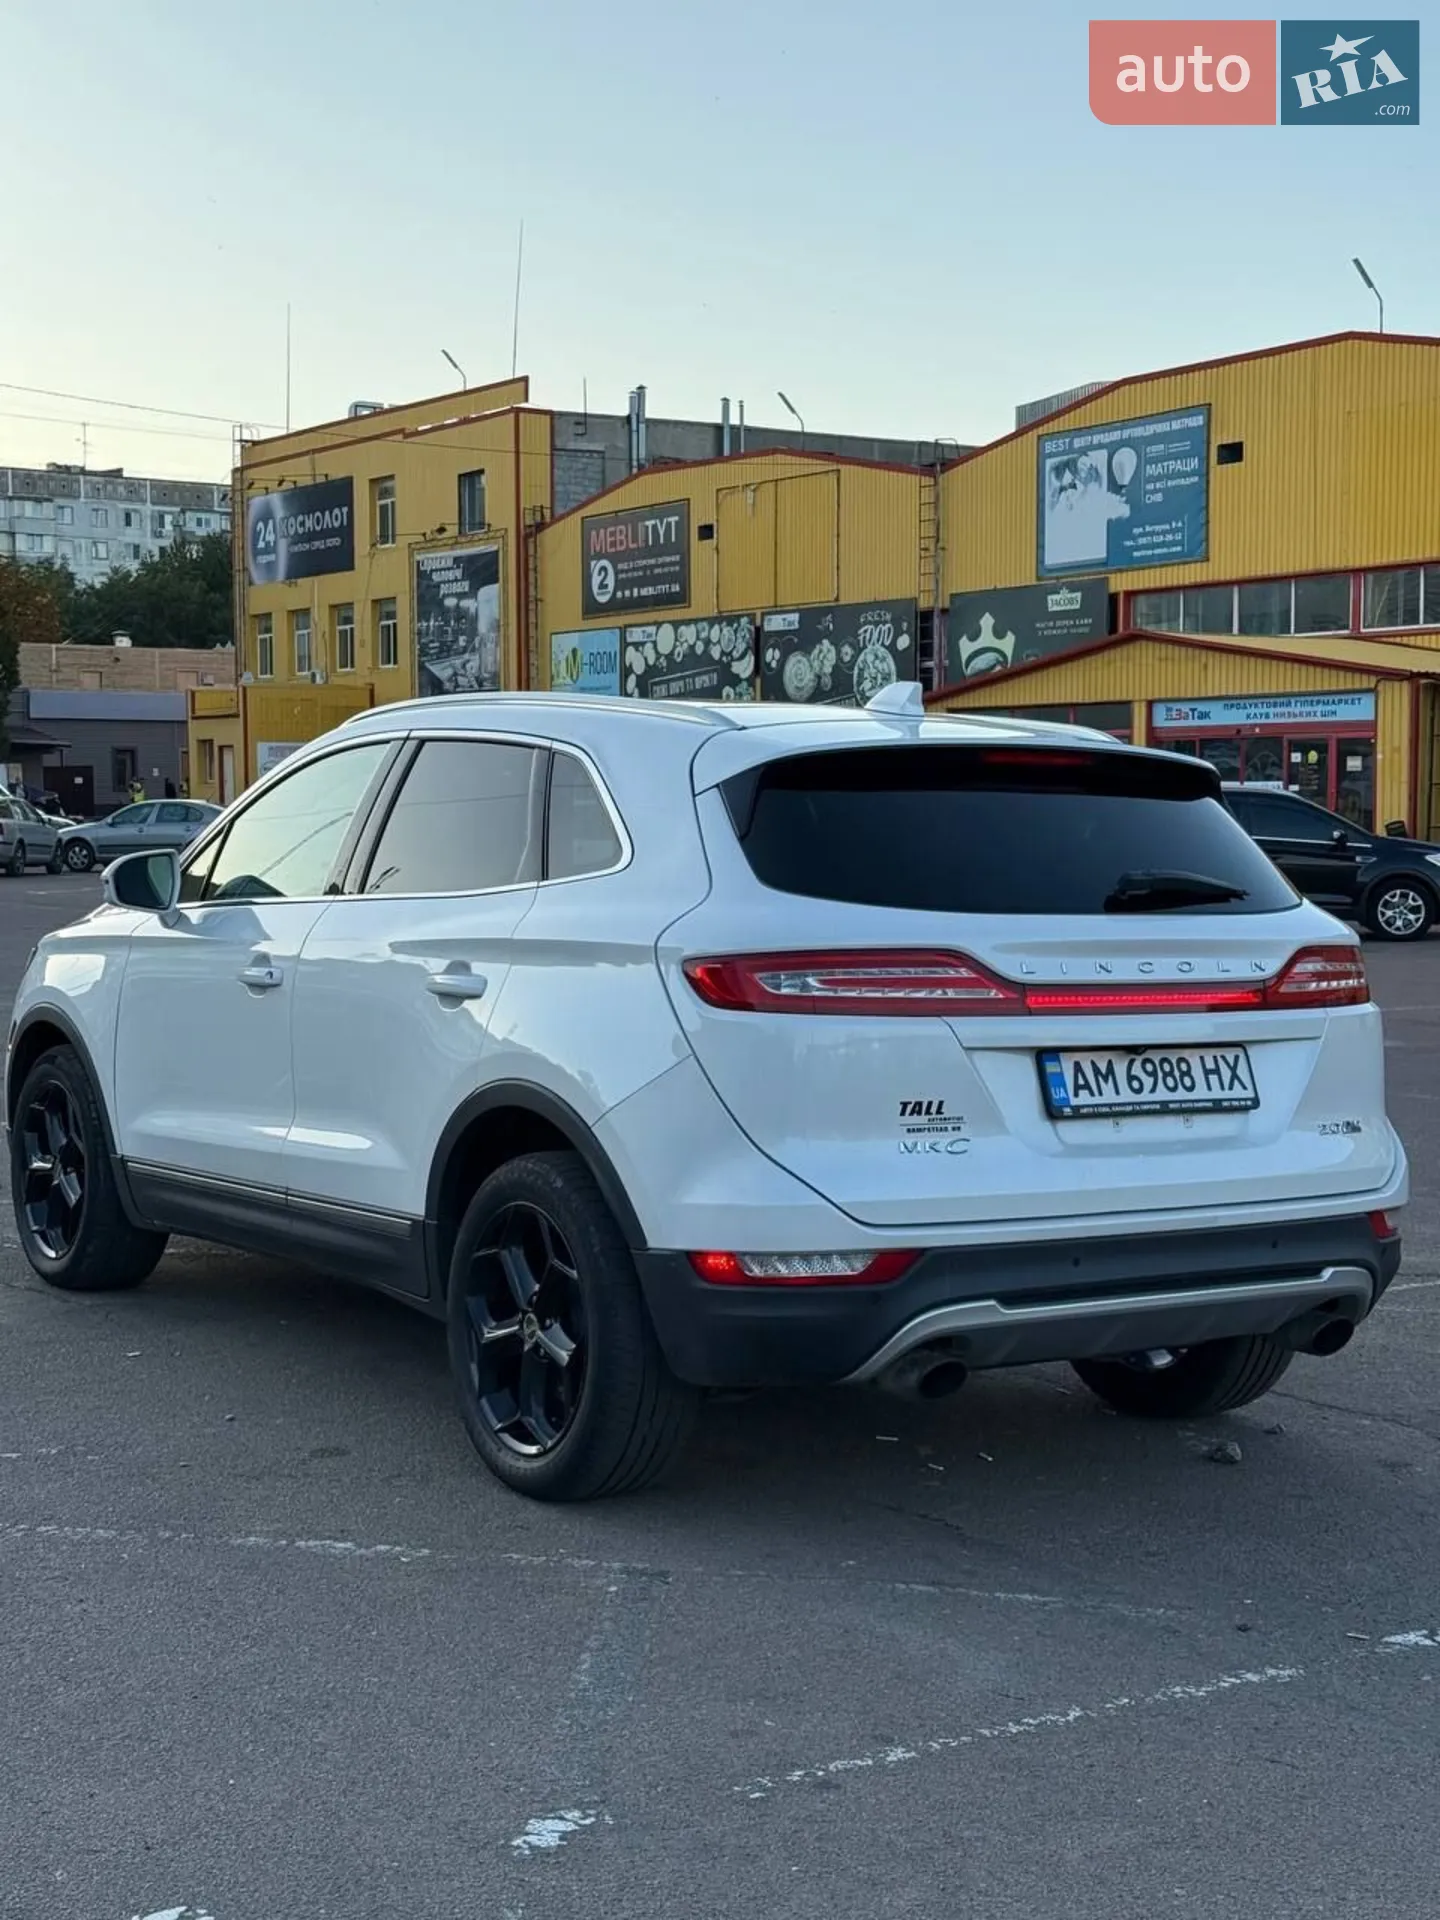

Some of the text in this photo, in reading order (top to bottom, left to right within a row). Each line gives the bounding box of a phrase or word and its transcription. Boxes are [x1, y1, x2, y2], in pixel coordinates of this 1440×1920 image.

[1045, 438, 1071, 453] BEST
[1146, 456, 1199, 477] МАТРАЦИ
[256, 506, 349, 549] 24 КОСМОЛОТ
[597, 565, 609, 590] 2
[1050, 596, 1080, 609] JACOBS
[860, 610, 892, 624] FRESH
[858, 624, 895, 648] FOOD
[1223, 697, 1362, 711] ПРОДУКТОВИЙ ГІПЕРМАРКЕТ
[1246, 711, 1271, 721] КЛУБ
[1273, 710, 1318, 720] НИЗЬКИХ
[1020, 960, 1267, 975] LINCOLN
[1072, 1053, 1248, 1099] AM 6988 HX
[1051, 1086, 1068, 1099] UA
[899, 1100, 945, 1117] TALL
[899, 1138, 971, 1155] MKC
